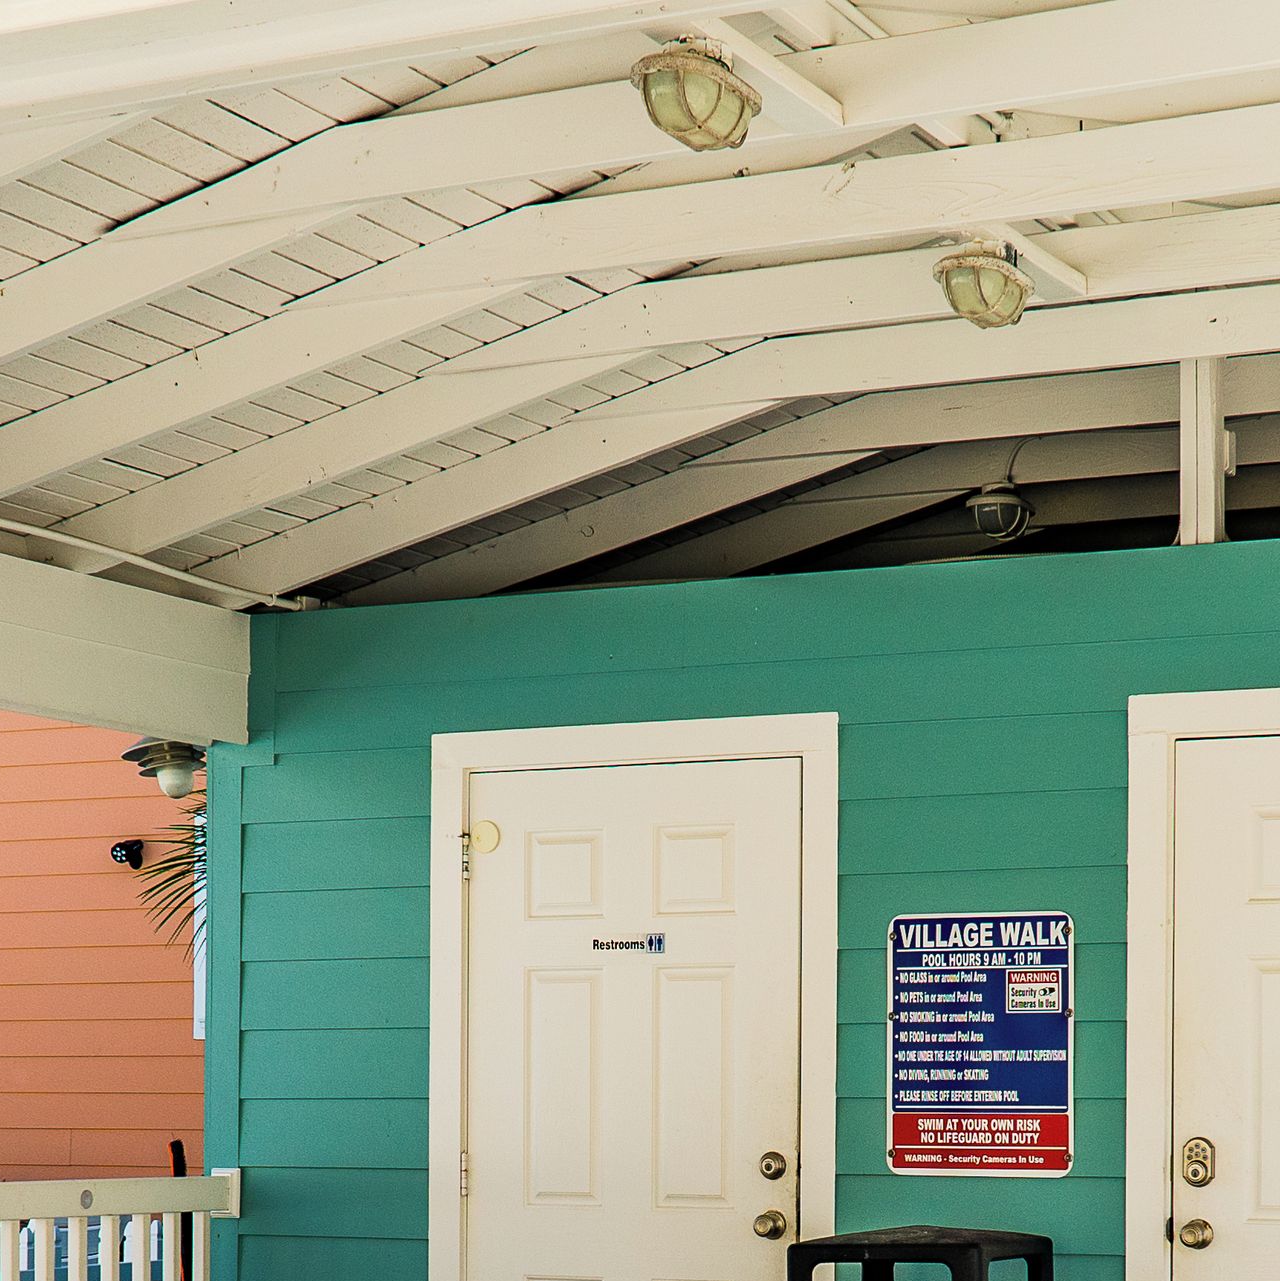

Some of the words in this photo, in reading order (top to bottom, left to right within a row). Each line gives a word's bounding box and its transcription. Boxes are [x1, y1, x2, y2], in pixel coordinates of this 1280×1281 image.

[900, 922, 994, 948] VILLAGE
[1000, 921, 1067, 946] WALK
[593, 939, 645, 950] Restrooms
[922, 954, 947, 967] POOL
[949, 953, 981, 966] HOURS
[984, 953, 989, 966] 9
[992, 953, 1006, 965] AM
[1014, 952, 1025, 965] 10
[1028, 952, 1041, 965] PM
[900, 972, 908, 984] NO
[910, 972, 927, 984] GLASS
[928, 972, 933, 983] in
[934, 975, 940, 983] or
[942, 971, 960, 983] around
[961, 971, 973, 982] Pool
[974, 971, 987, 982] Area
[1011, 973, 1057, 982] WARNING
[900, 992, 908, 1003] NO
[910, 992, 923, 1003] PETS
[925, 992, 930, 1003] in
[931, 995, 936, 1003] or
[937, 991, 956, 1003] around
[957, 991, 968, 1002] Pool
[970, 991, 983, 1002] Area
[1011, 987, 1037, 998] Security
[1011, 999, 1036, 1008] Cameras
[1046, 999, 1056, 1008] Use
[900, 1011, 908, 1023] NO
[910, 1011, 935, 1023] SMOKING
[936, 1011, 941, 1022] in
[942, 1013, 948, 1022] or
[949, 1011, 968, 1022] around
[969, 1011, 980, 1022] Pool
[981, 1011, 995, 1022] Area
[900, 1031, 908, 1042] NO
[909, 1031, 924, 1042] FOOD
[925, 1031, 930, 1042] in
[932, 1033, 937, 1042] or
[938, 1031, 957, 1042] around
[958, 1031, 970, 1042] Pool
[971, 1031, 984, 1042] Area
[898, 1050, 905, 1062] NO
[907, 1050, 916, 1062] ONE
[918, 1050, 933, 1062] UNDER
[934, 1050, 944, 1062] THE
[945, 1050, 955, 1062] AGE
[956, 1050, 962, 1062] OF
[970, 1050, 992, 1062] ALLOWED
[993, 1050, 1016, 1062] WITHOUT
[1017, 1050, 1032, 1062] ADULT
[1033, 1050, 1066, 1062] SUPERVISION
[899, 1069, 907, 1080] NO
[930, 1069, 956, 1080] RUNNING
[957, 1072, 963, 1080] or
[964, 1069, 989, 1080] SKATING
[900, 1091, 920, 1102] PLEASE
[922, 1091, 938, 1102] RINSE
[939, 1091, 949, 1102] OFF
[951, 1091, 972, 1102] BEFORE
[974, 1091, 1002, 1102] ENTERING
[1004, 1091, 1019, 1102] POOL
[918, 1119, 944, 1131] SWIM
[946, 1119, 958, 1131] AT
[961, 1119, 989, 1131] YOUR
[991, 1119, 1014, 1131] OWN
[1017, 1119, 1041, 1131] RISK
[921, 1133, 935, 1144] NO
[937, 1133, 992, 1144] LIFEGUARD
[994, 1133, 1010, 1144] ON
[1012, 1133, 1040, 1144] DUTY
[905, 1154, 942, 1162] WARNING
[949, 1155, 980, 1165] Security
[982, 1155, 1017, 1163] Cameras
[1028, 1156, 1044, 1164] Use
